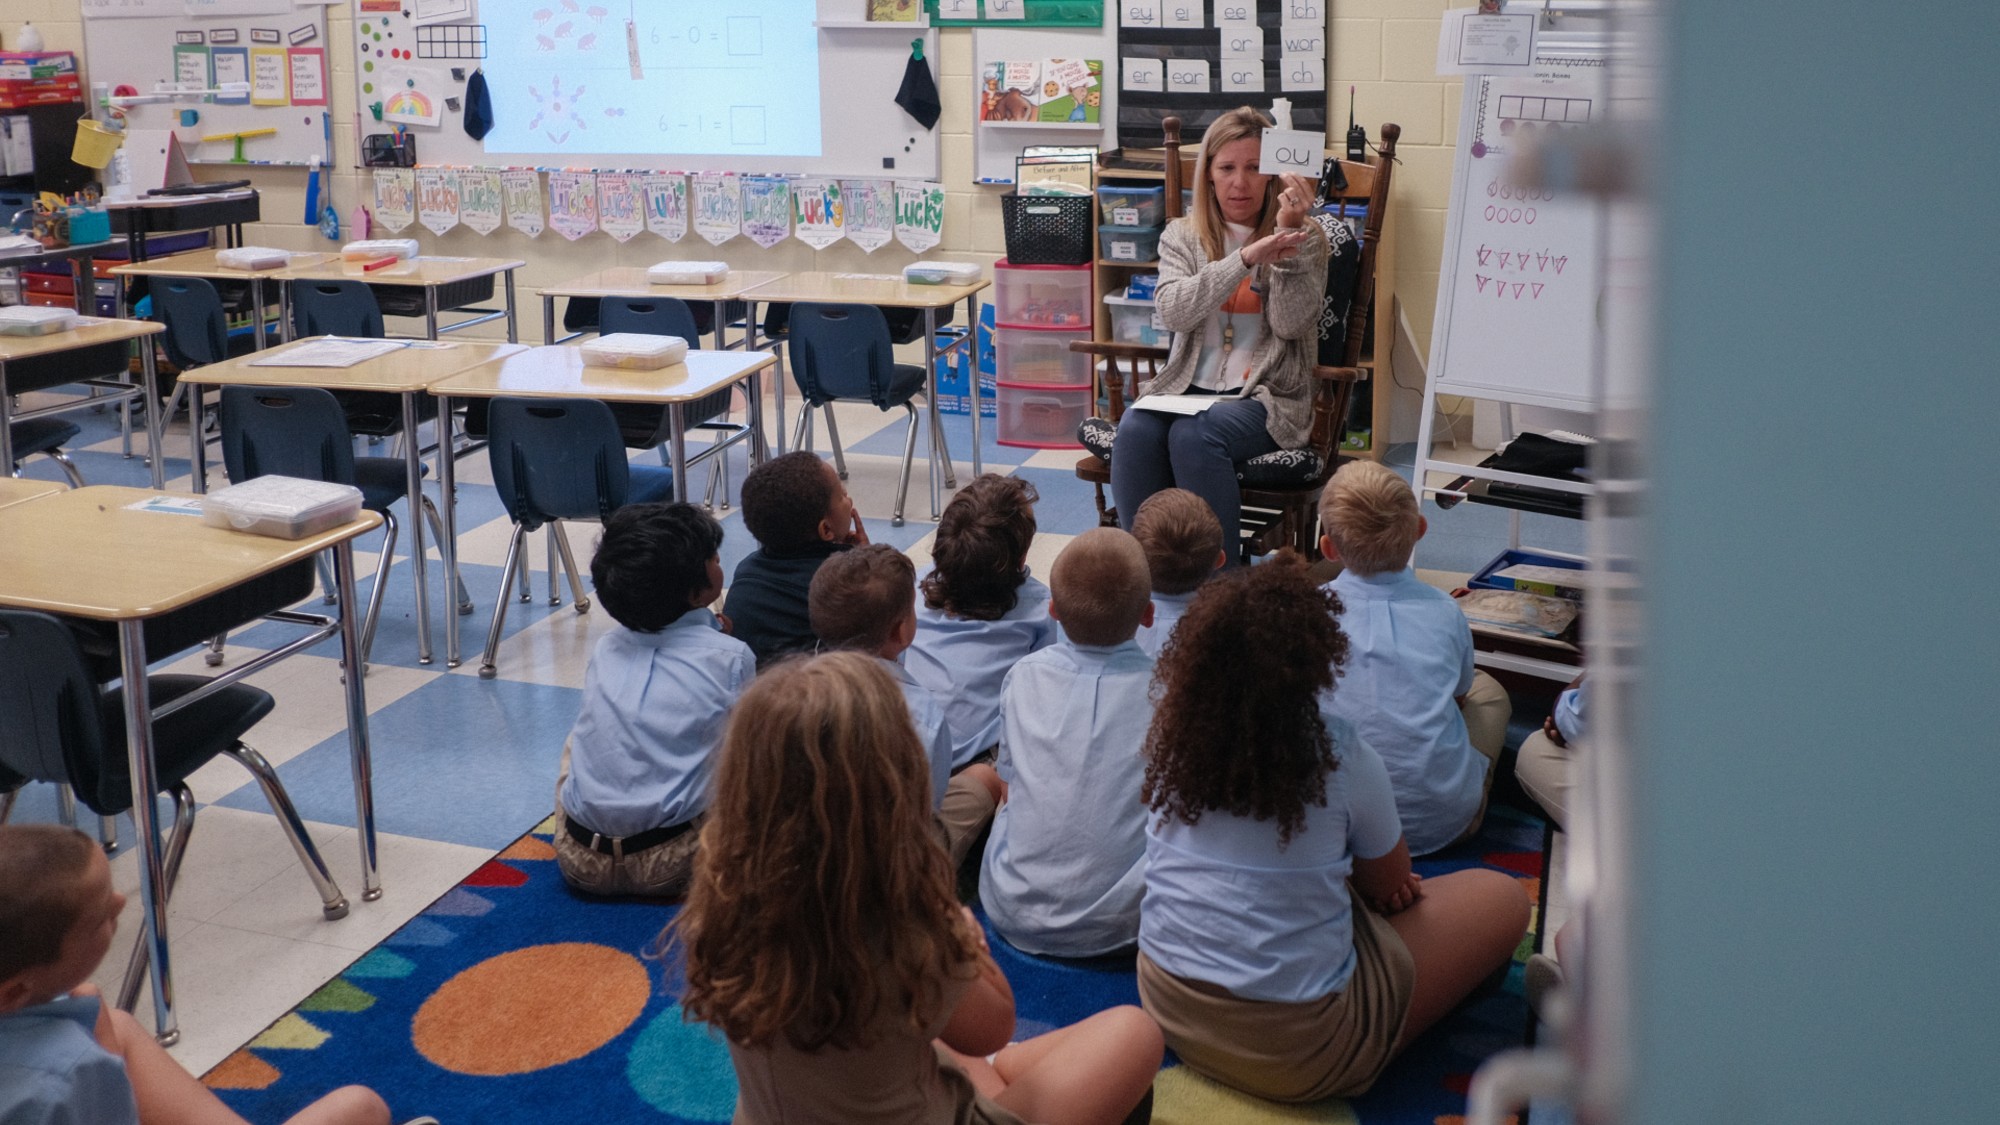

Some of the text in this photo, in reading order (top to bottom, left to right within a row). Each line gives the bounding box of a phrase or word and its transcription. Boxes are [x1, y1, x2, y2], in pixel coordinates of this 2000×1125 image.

[1130, 7, 1153, 25] ey
[1224, 7, 1247, 20] ee
[1291, 0, 1317, 19] tch
[651, 26, 660, 44] 6
[1231, 37, 1253, 51] or
[1285, 37, 1320, 51] wor
[1133, 70, 1153, 83] er
[1172, 71, 1204, 84] ear
[1231, 71, 1253, 84] ar
[1292, 61, 1314, 83] ch
[659, 114, 668, 132] 6
[1276, 147, 1310, 165] ou
[1033, 165, 1056, 174] Before
[1070, 165, 1087, 173] After
[549, 183, 594, 220] Lucky
[598, 186, 641, 221] Lucky
[693, 187, 739, 225] Lucky
[742, 189, 789, 227] Lucky
[794, 191, 843, 228] Lucky
[843, 193, 892, 231] Lucky
[895, 191, 943, 233] Lucky
